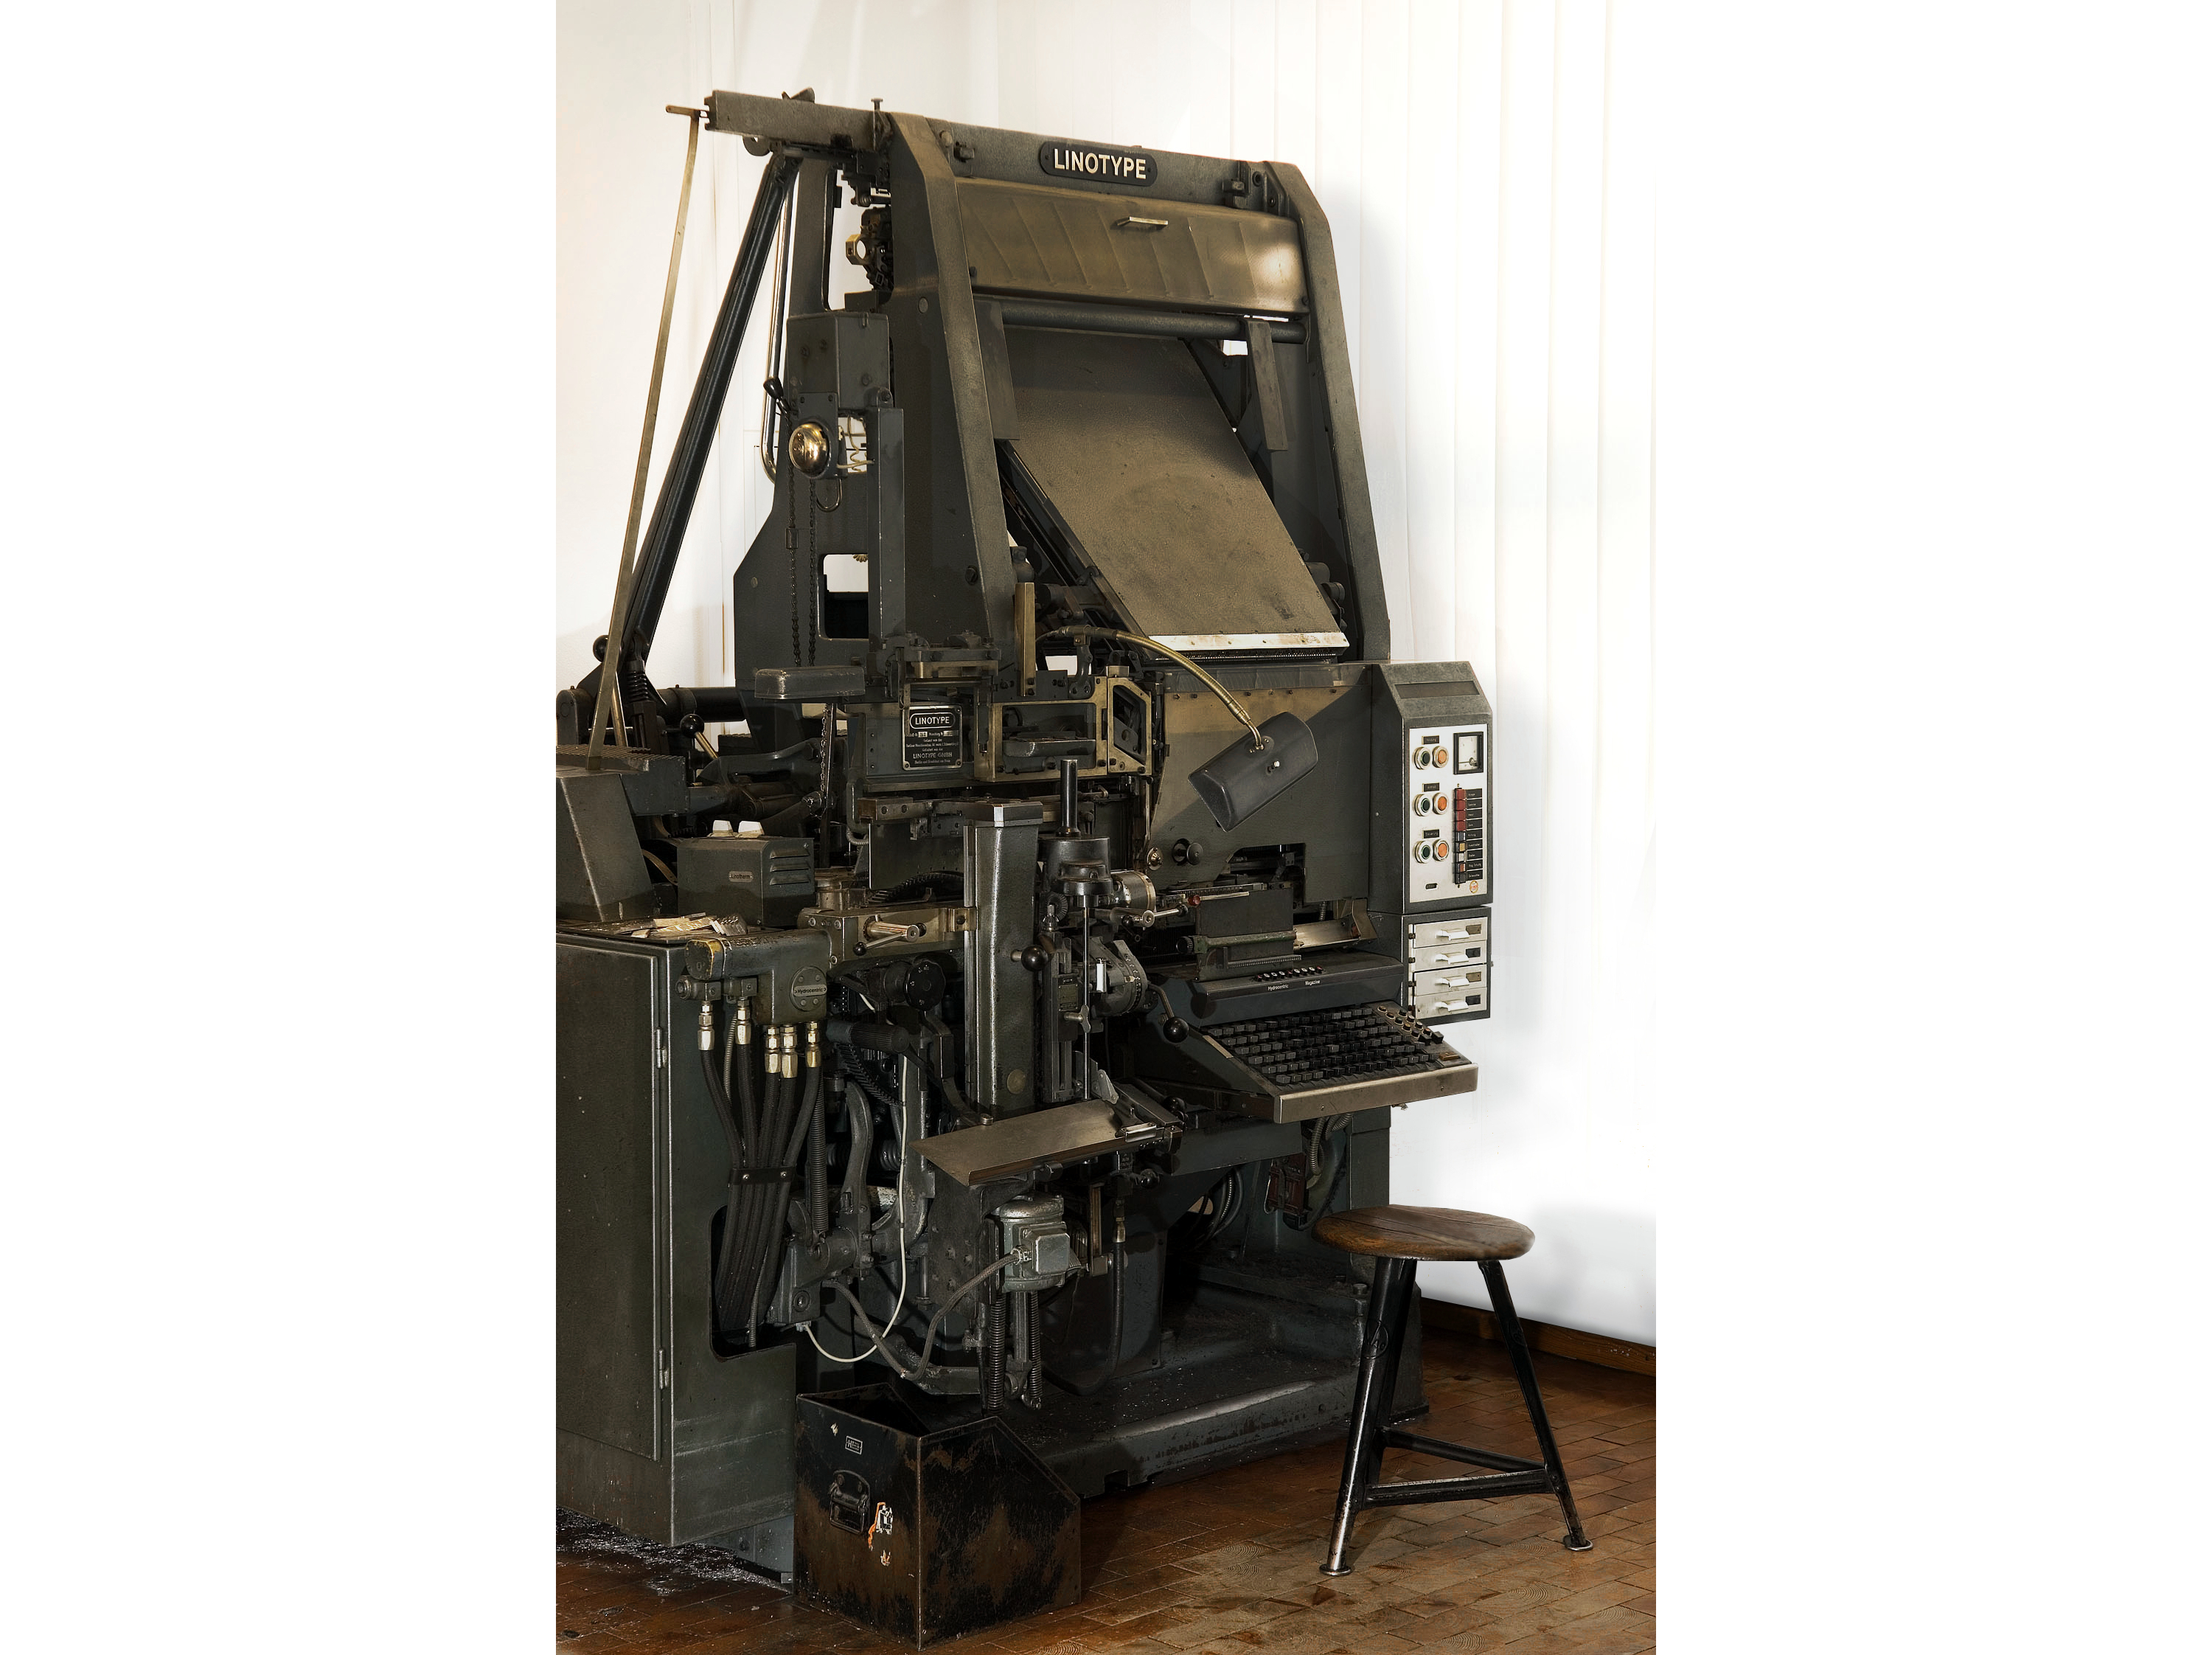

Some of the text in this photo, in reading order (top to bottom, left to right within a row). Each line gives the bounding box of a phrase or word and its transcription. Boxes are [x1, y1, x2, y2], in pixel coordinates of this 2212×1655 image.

[1054, 148, 1147, 179] LINOTYPE
[915, 716, 950, 725] LINOTYPE
[1267, 983, 1289, 991] Hydrocentric
